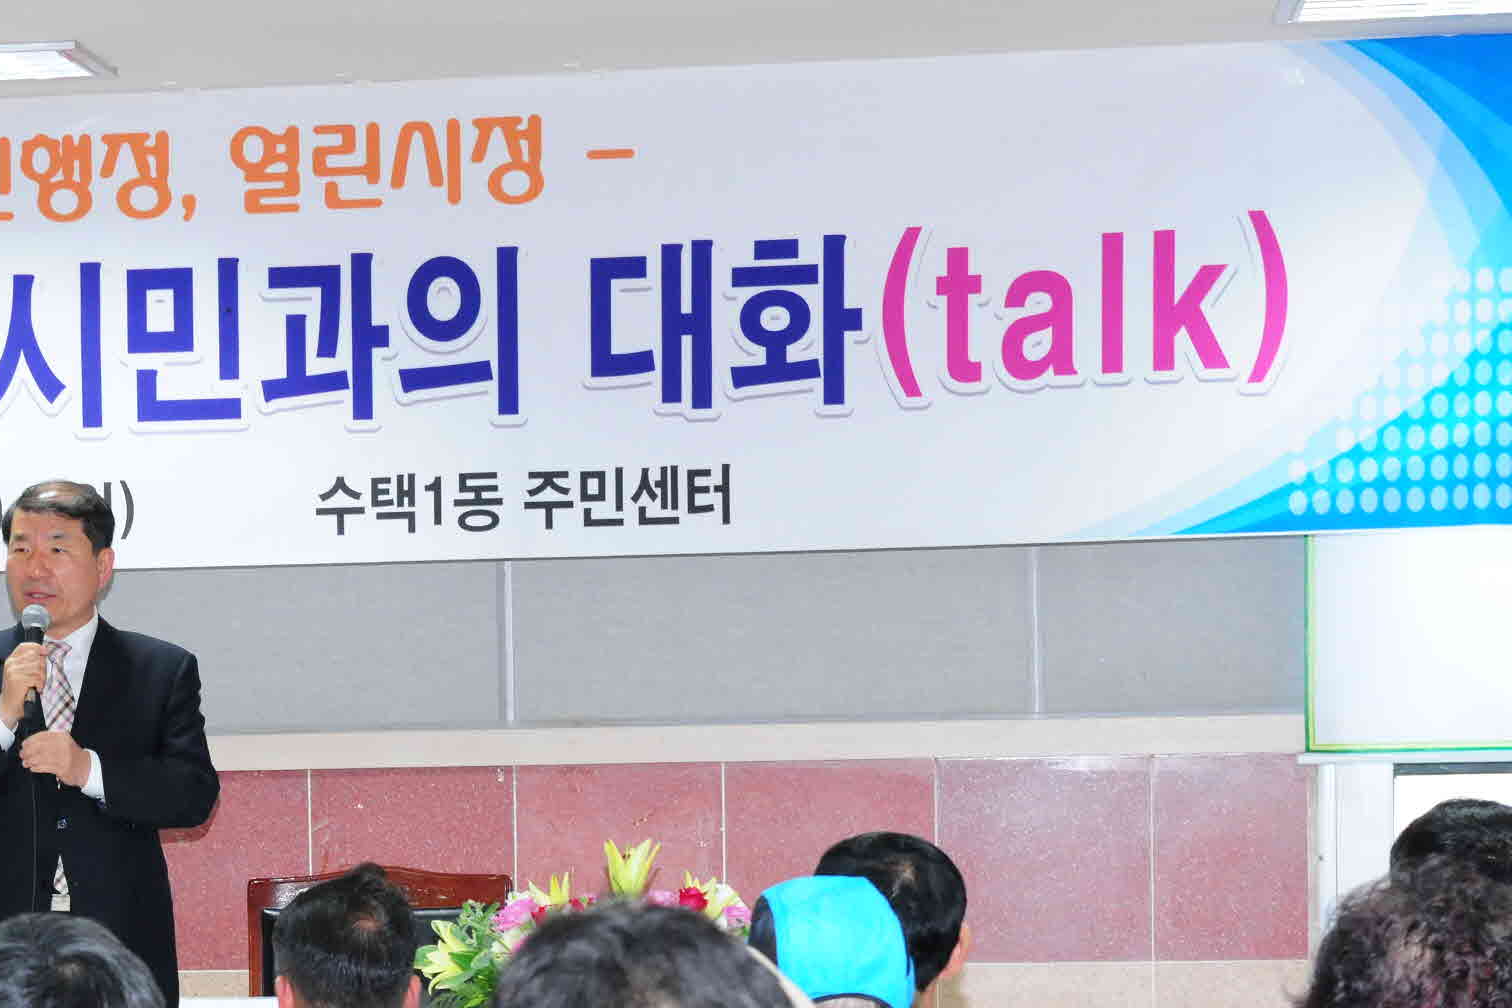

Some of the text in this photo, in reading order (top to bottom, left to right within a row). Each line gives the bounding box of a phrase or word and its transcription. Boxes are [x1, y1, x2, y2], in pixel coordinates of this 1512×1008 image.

[229, 114, 546, 214] 열린시정
[315, 463, 731, 536] 수택1동 주민센터
